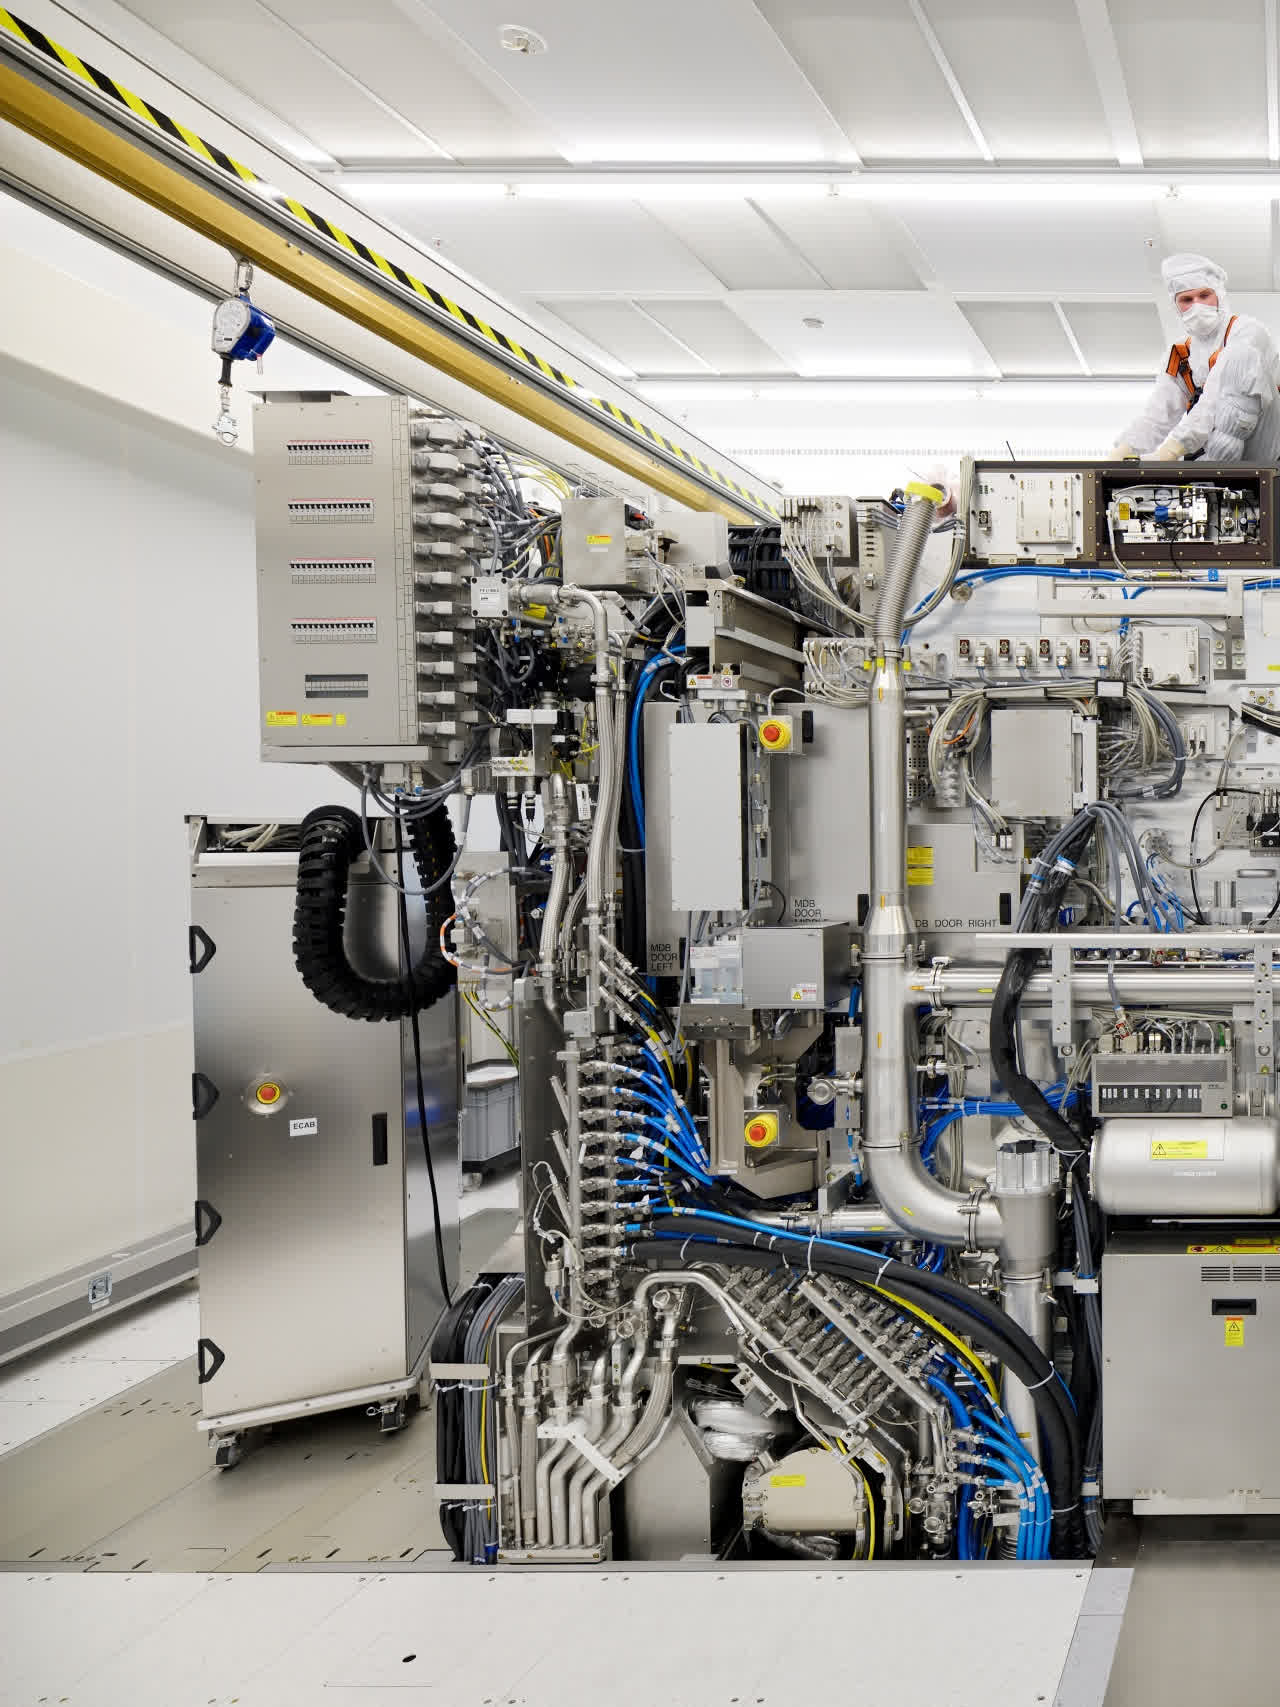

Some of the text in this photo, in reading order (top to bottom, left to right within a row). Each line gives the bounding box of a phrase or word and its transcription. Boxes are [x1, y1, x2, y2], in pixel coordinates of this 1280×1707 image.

[794, 899, 816, 908] MDB
[794, 908, 822, 918] DOOR
[915, 919, 998, 928] DB DOOR RIGHT
[650, 943, 671, 952] MDB
[650, 952, 678, 961] DOOR
[650, 961, 673, 971] LEFT
[293, 1121, 315, 1130] ECAB
